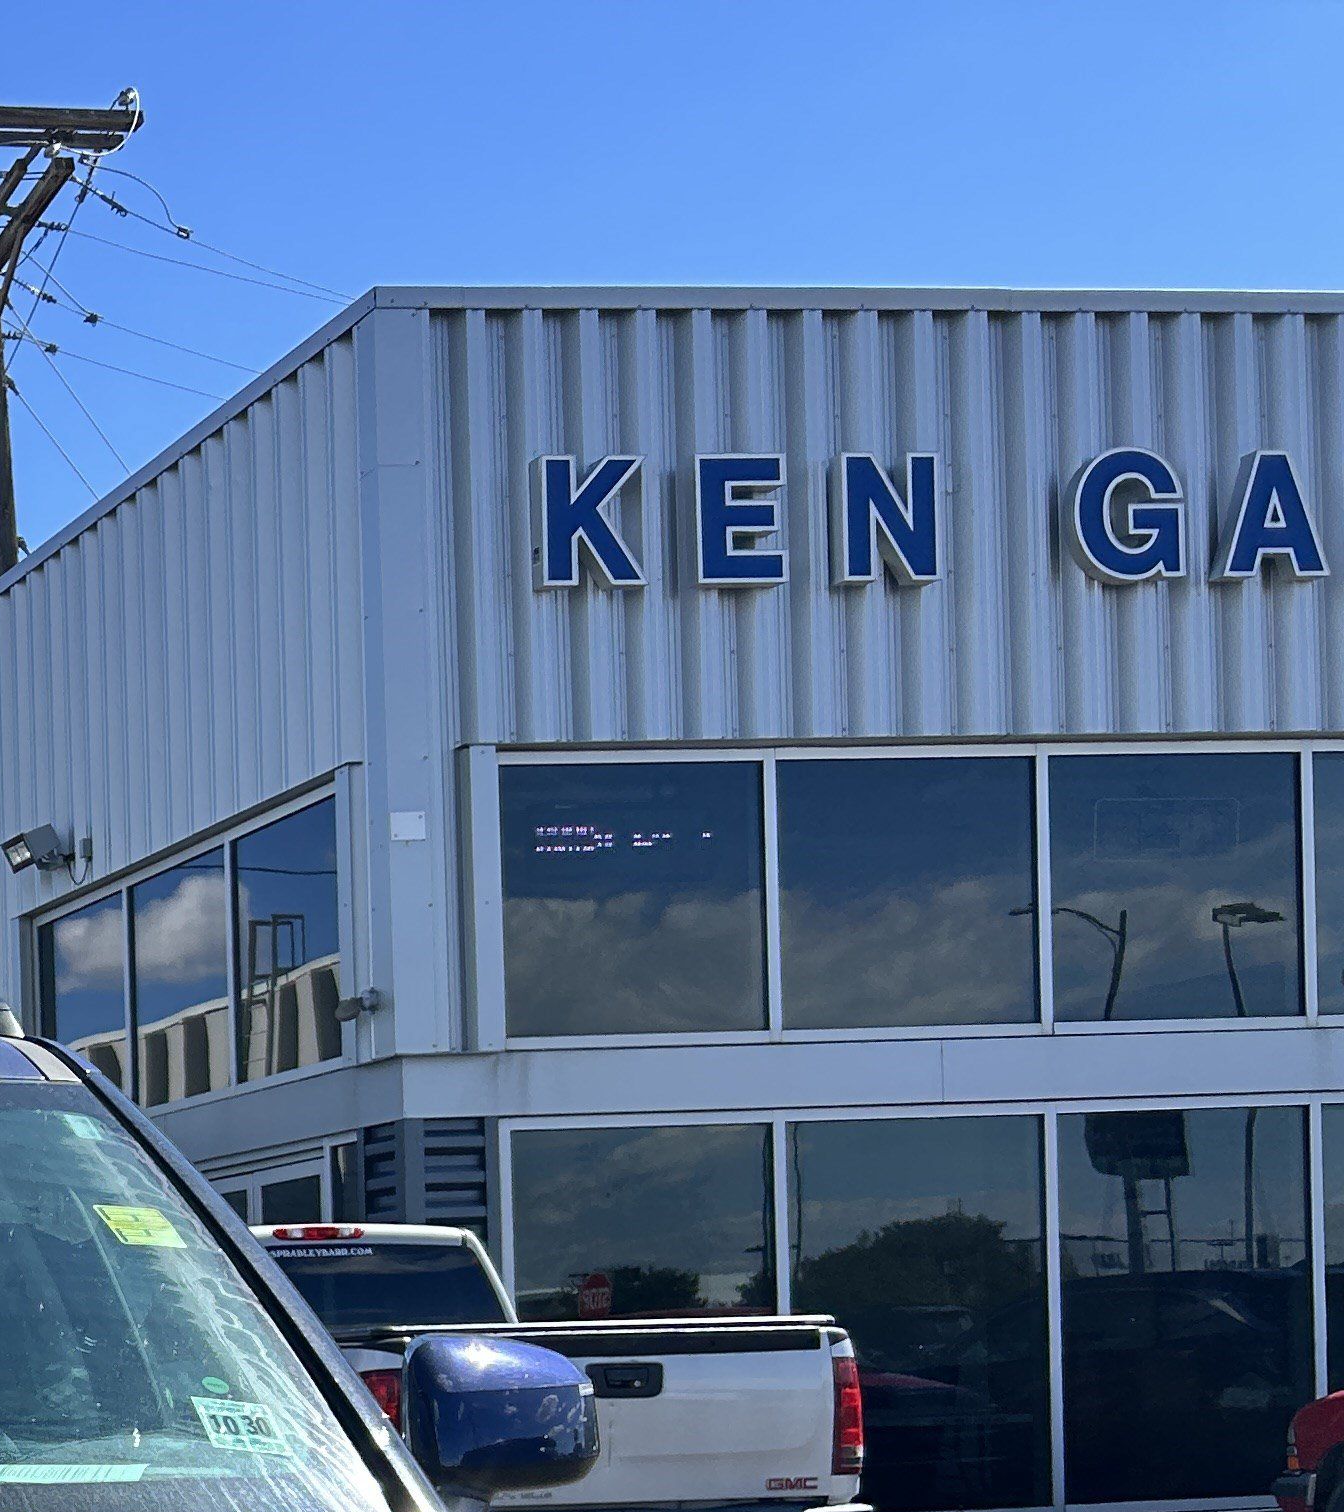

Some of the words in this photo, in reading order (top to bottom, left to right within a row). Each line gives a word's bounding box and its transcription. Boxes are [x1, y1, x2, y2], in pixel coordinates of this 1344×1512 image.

[533, 451, 942, 590] KEN
[1068, 446, 1330, 586] GA
[765, 1477, 818, 1491] GMC
